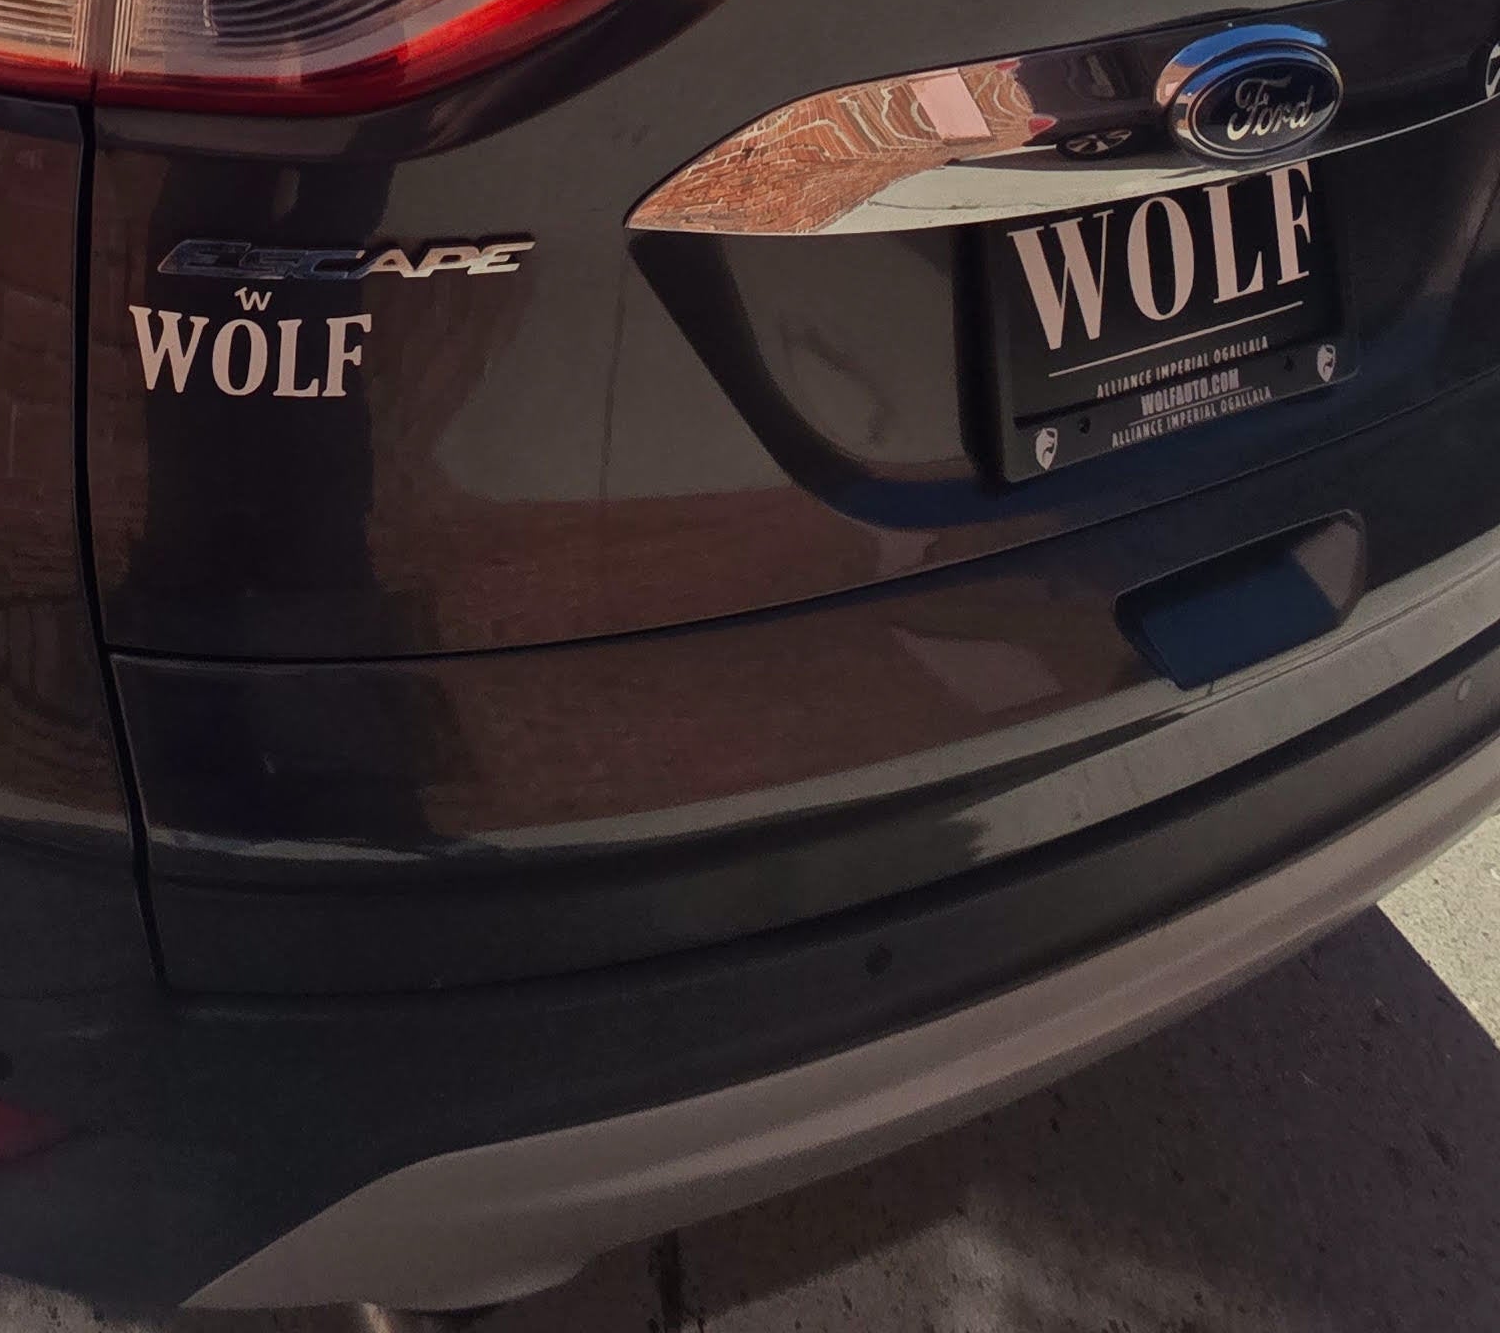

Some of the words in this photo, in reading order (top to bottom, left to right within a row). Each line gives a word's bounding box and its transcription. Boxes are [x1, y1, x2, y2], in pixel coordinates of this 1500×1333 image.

[1226, 76, 1315, 141] Ford
[157, 238, 537, 280] ESCAPE
[1006, 160, 1313, 351] WOLF
[128, 304, 373, 398] WOLF
[1096, 368, 1154, 399] ALLIANCE
[1155, 352, 1210, 381] IMPERIAL
[1212, 335, 1269, 364] OGALLALA
[1111, 419, 1164, 449] ALLIANCE
[1165, 403, 1218, 431] IMPERIAL
[1220, 385, 1273, 414] OGALLALA
[1140, 367, 1240, 416] WOLFAUTO.COM
